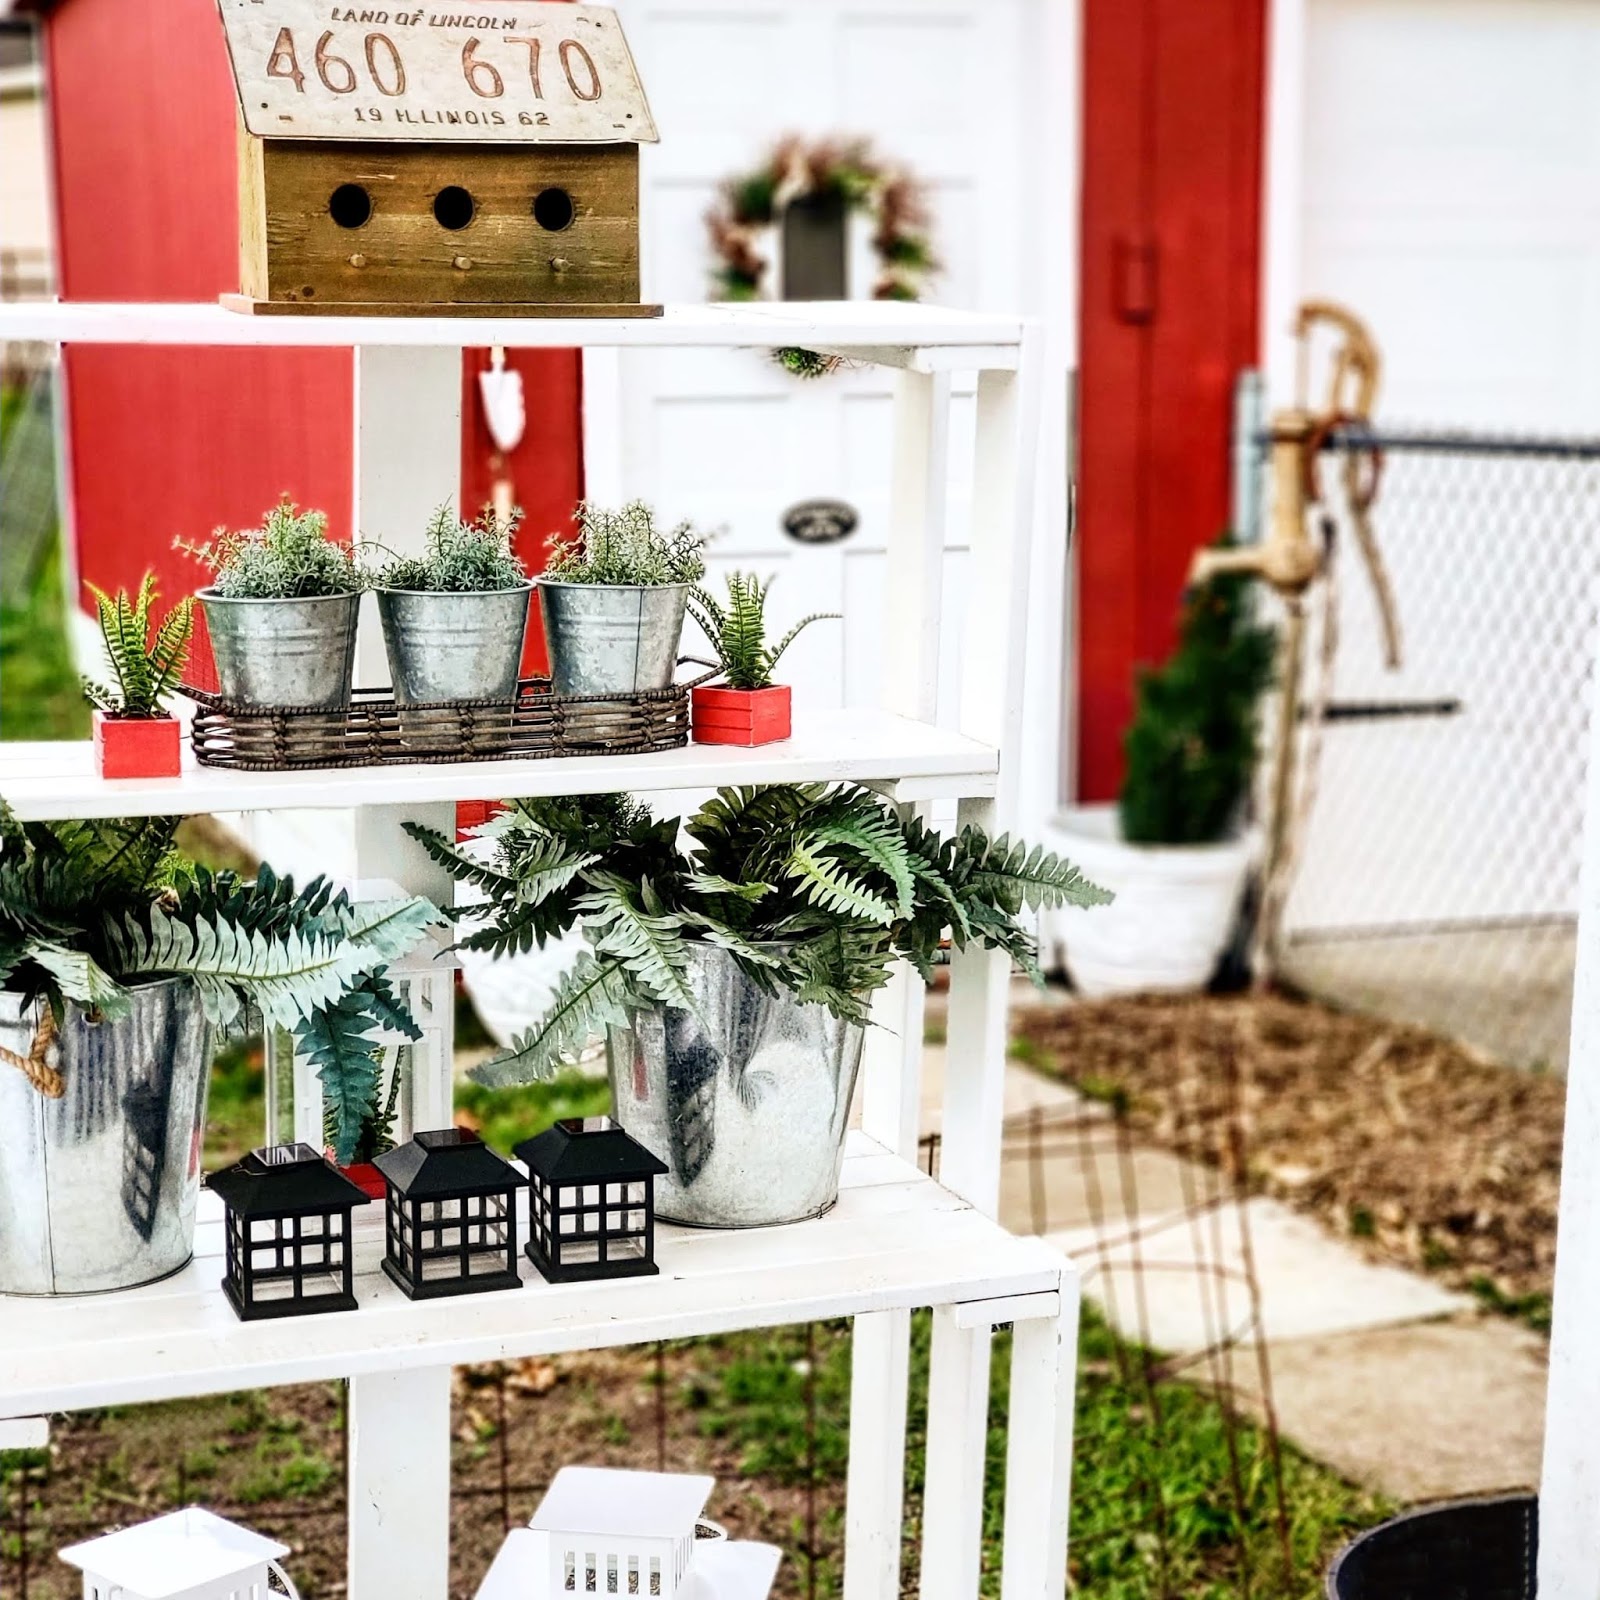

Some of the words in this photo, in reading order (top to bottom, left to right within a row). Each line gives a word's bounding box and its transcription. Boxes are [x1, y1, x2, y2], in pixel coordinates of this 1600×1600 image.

[331, 8, 388, 25] LAND
[395, 9, 423, 27] OF
[428, 13, 517, 30] LINCOLN
[266, 27, 407, 98] 460
[461, 35, 602, 101] 670
[355, 107, 383, 122] 19
[396, 108, 505, 126] ILLINOIS
[519, 111, 551, 126] 62
